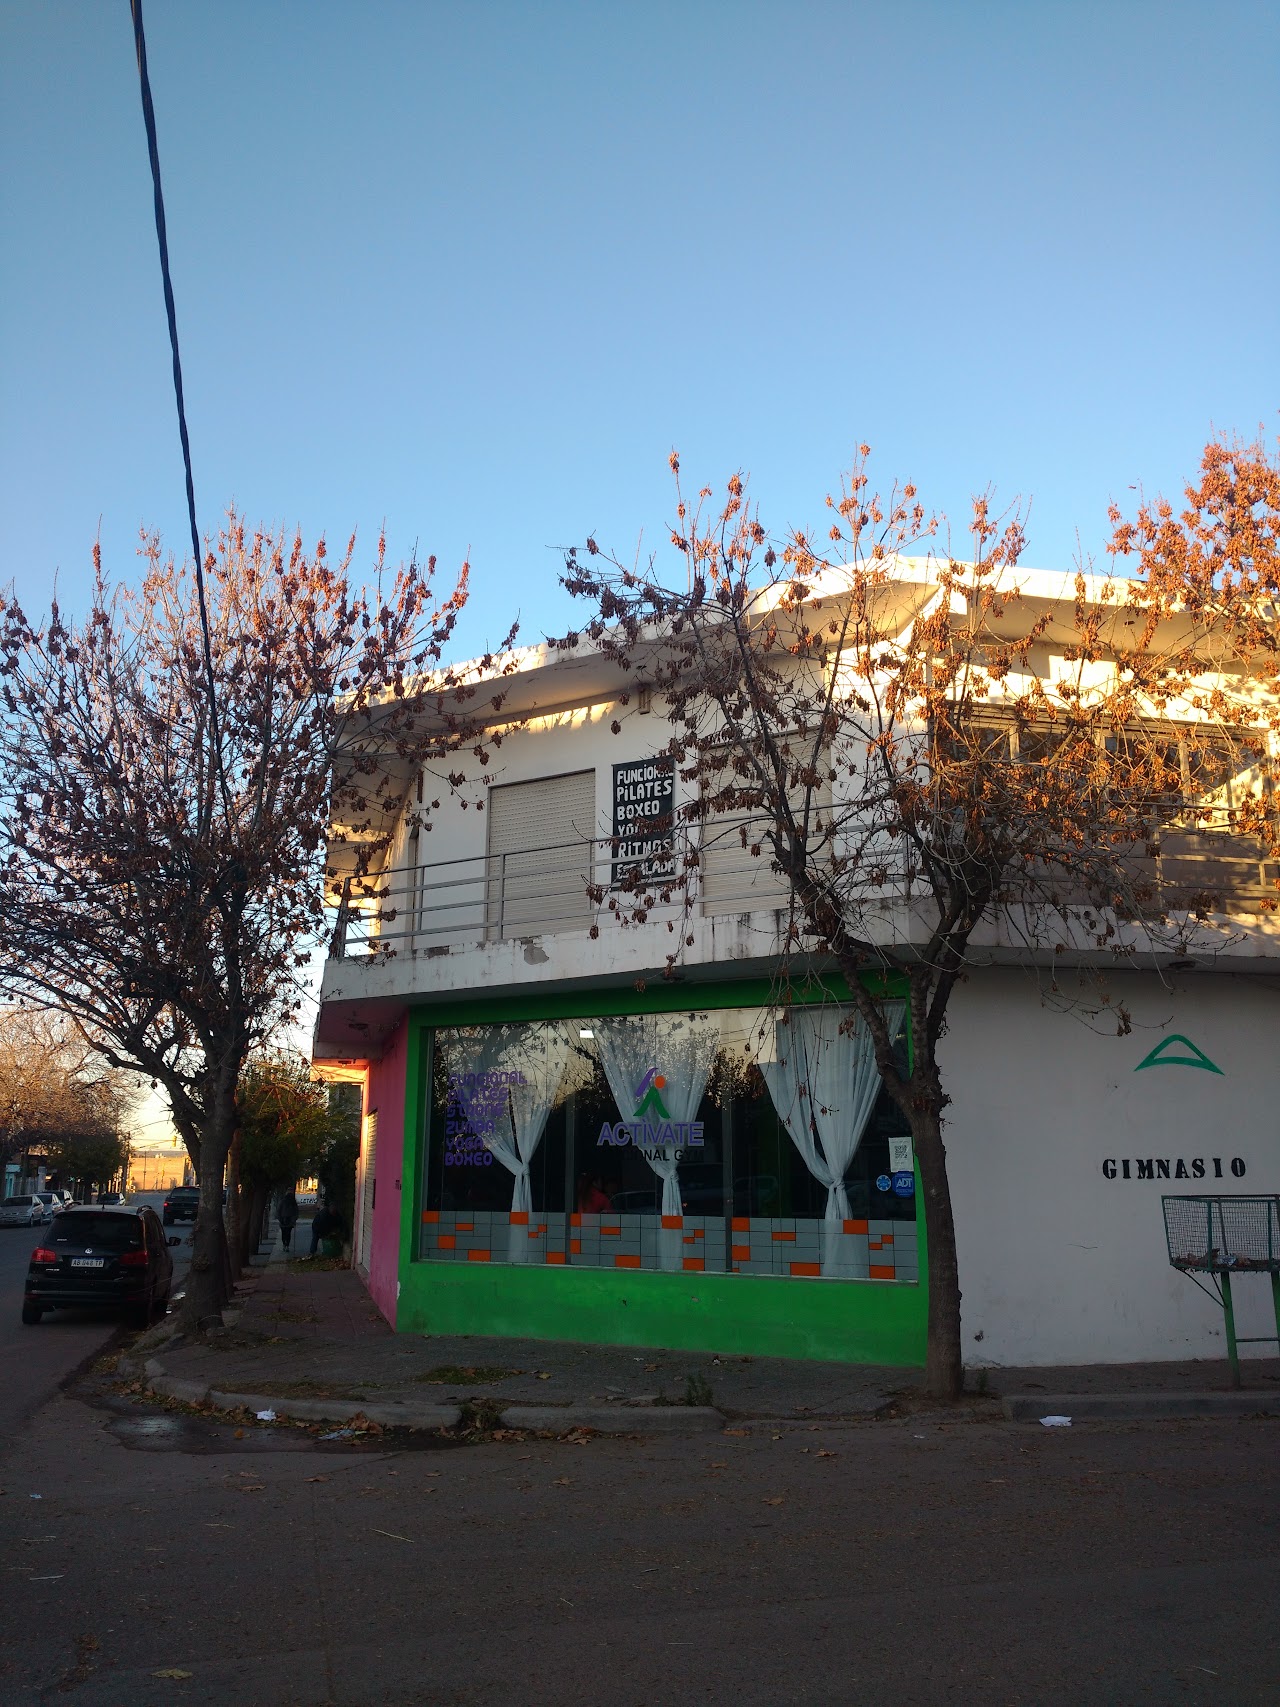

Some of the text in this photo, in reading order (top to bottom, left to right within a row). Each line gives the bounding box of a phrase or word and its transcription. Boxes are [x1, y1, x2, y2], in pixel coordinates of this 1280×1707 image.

[446, 1119, 496, 1134] ZUMBA
[446, 1136, 484, 1151] YOGA
[445, 1151, 493, 1167] BOXEO
[1102, 1157, 1247, 1180] GIMNASIO
[896, 1178, 913, 1188] ADT
